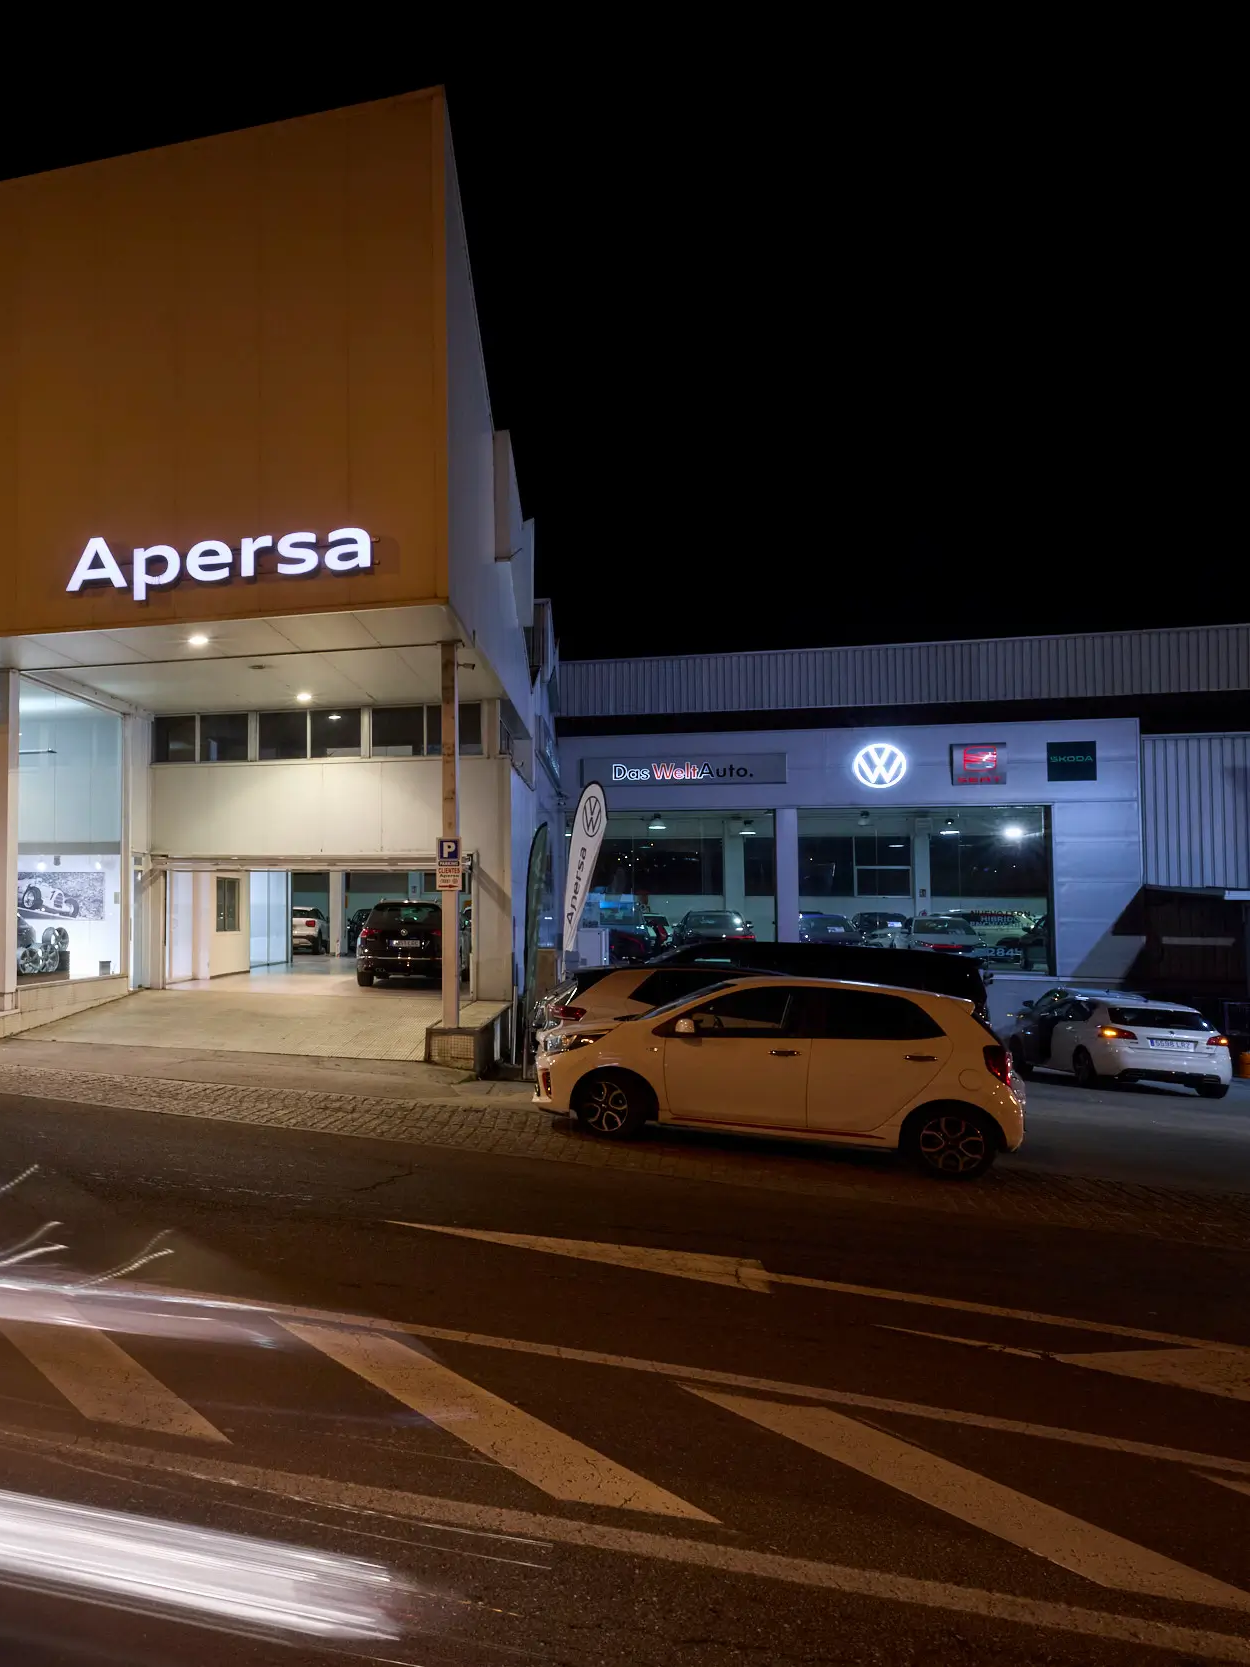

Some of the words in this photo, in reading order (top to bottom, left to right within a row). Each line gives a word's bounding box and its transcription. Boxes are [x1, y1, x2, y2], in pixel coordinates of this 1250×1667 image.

[65, 526, 373, 601] Apersa
[612, 763, 651, 781] Das
[443, 841, 456, 858] P
[566, 846, 587, 925] Apersa
